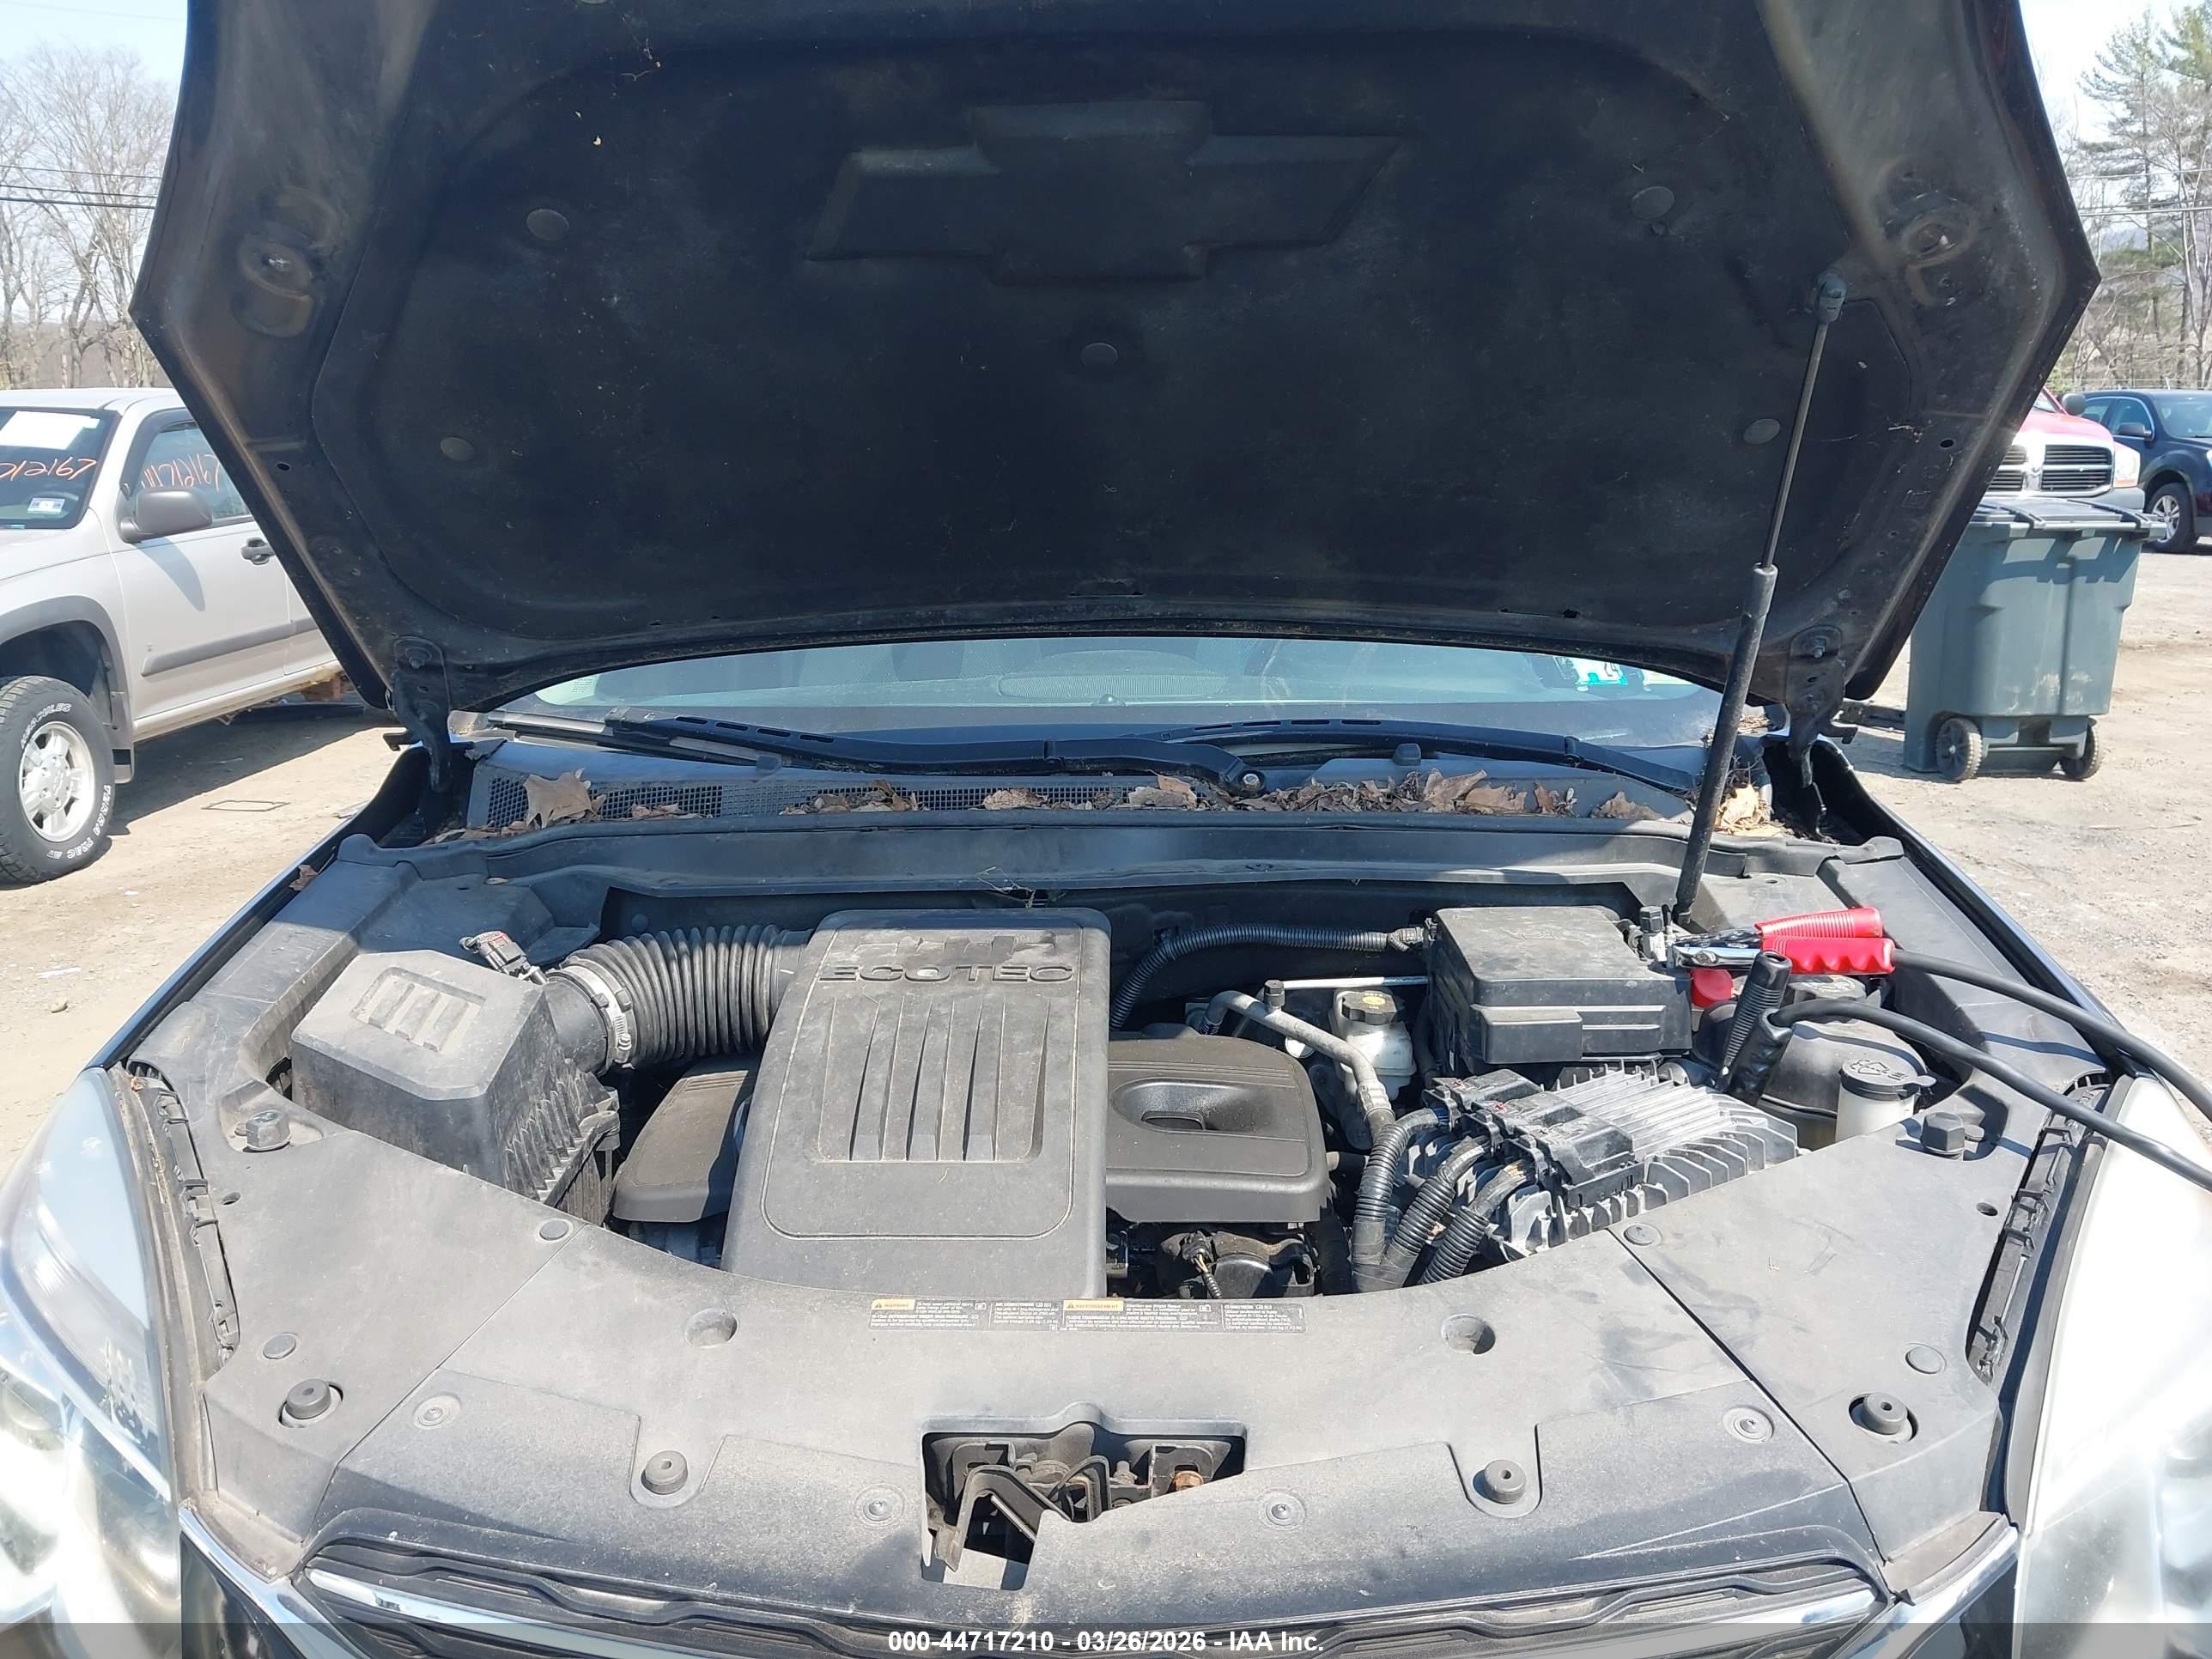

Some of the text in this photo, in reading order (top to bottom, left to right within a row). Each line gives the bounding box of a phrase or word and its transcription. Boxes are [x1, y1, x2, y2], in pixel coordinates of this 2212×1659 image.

[93, 784, 112, 836] TERRA
[66, 836, 94, 859] TRAC
[819, 964, 1073, 982] ECOTEC
